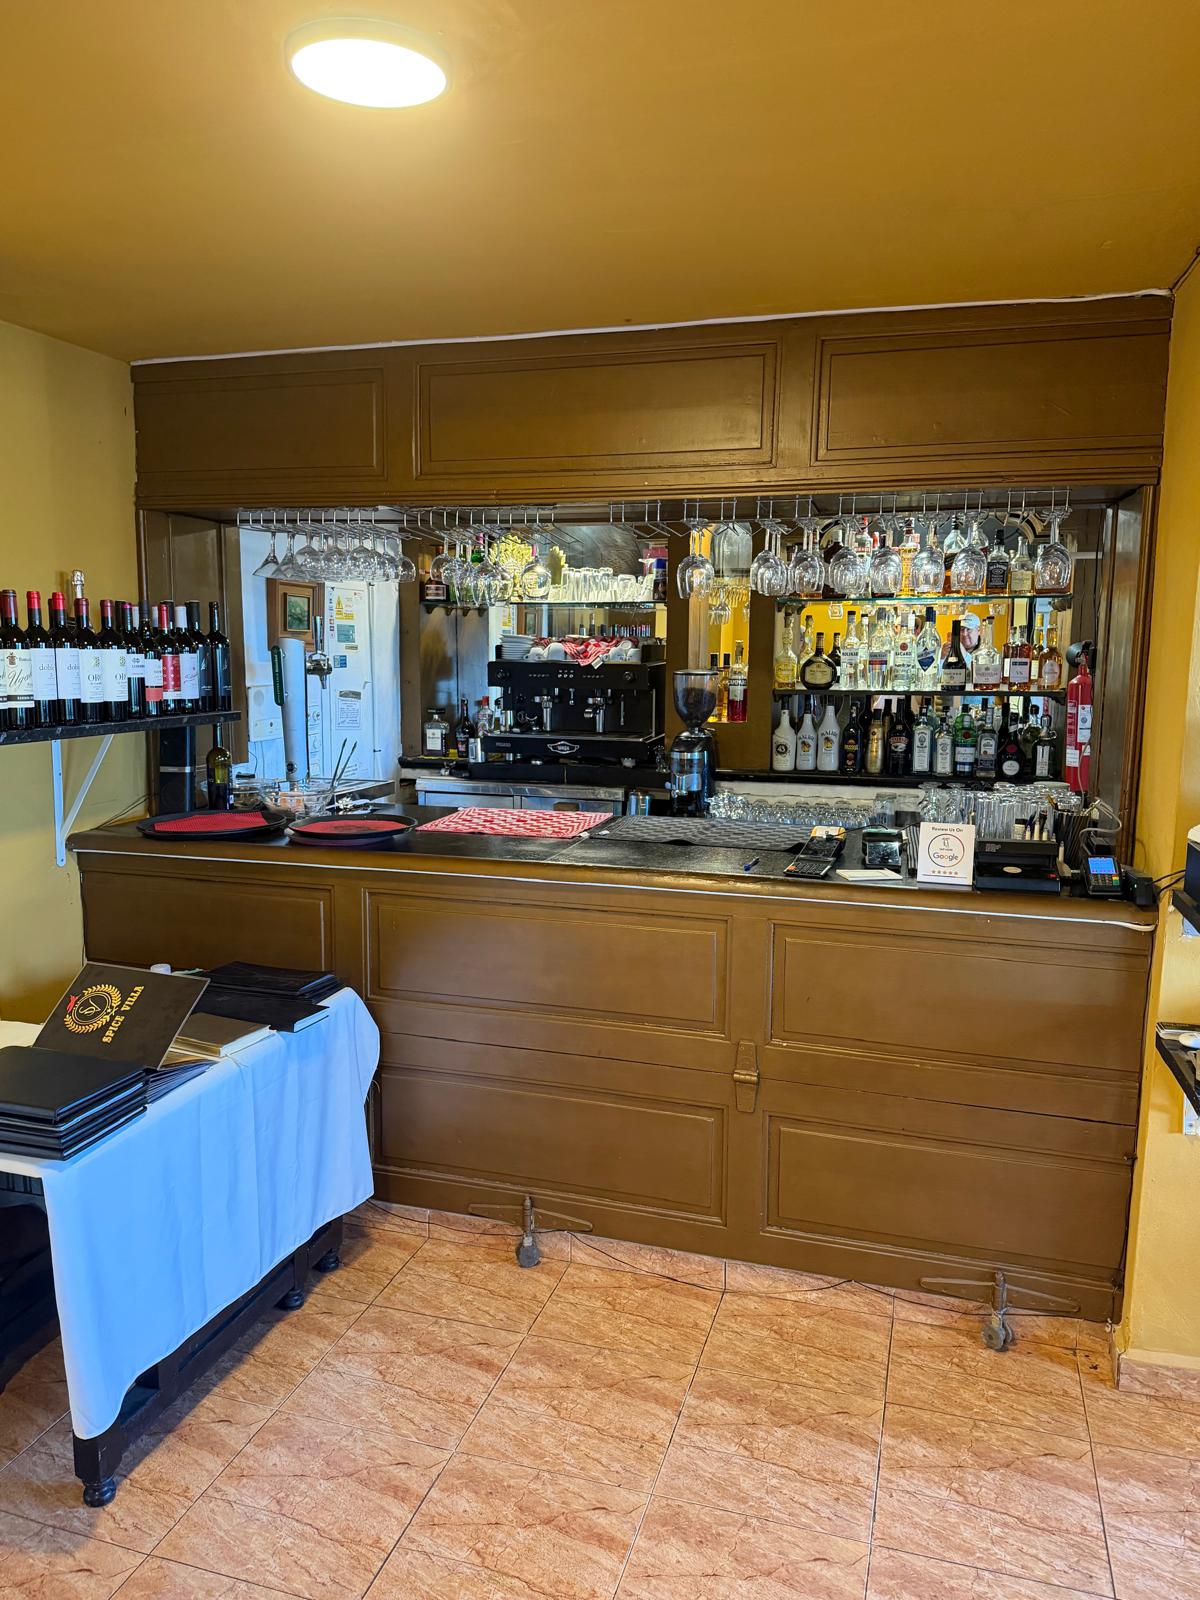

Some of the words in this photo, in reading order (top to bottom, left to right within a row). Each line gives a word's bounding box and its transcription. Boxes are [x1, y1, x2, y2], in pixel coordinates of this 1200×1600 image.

[932, 852, 959, 861] Google
[101, 1015, 125, 1044] SPICE
[120, 985, 145, 1012] VILLA
